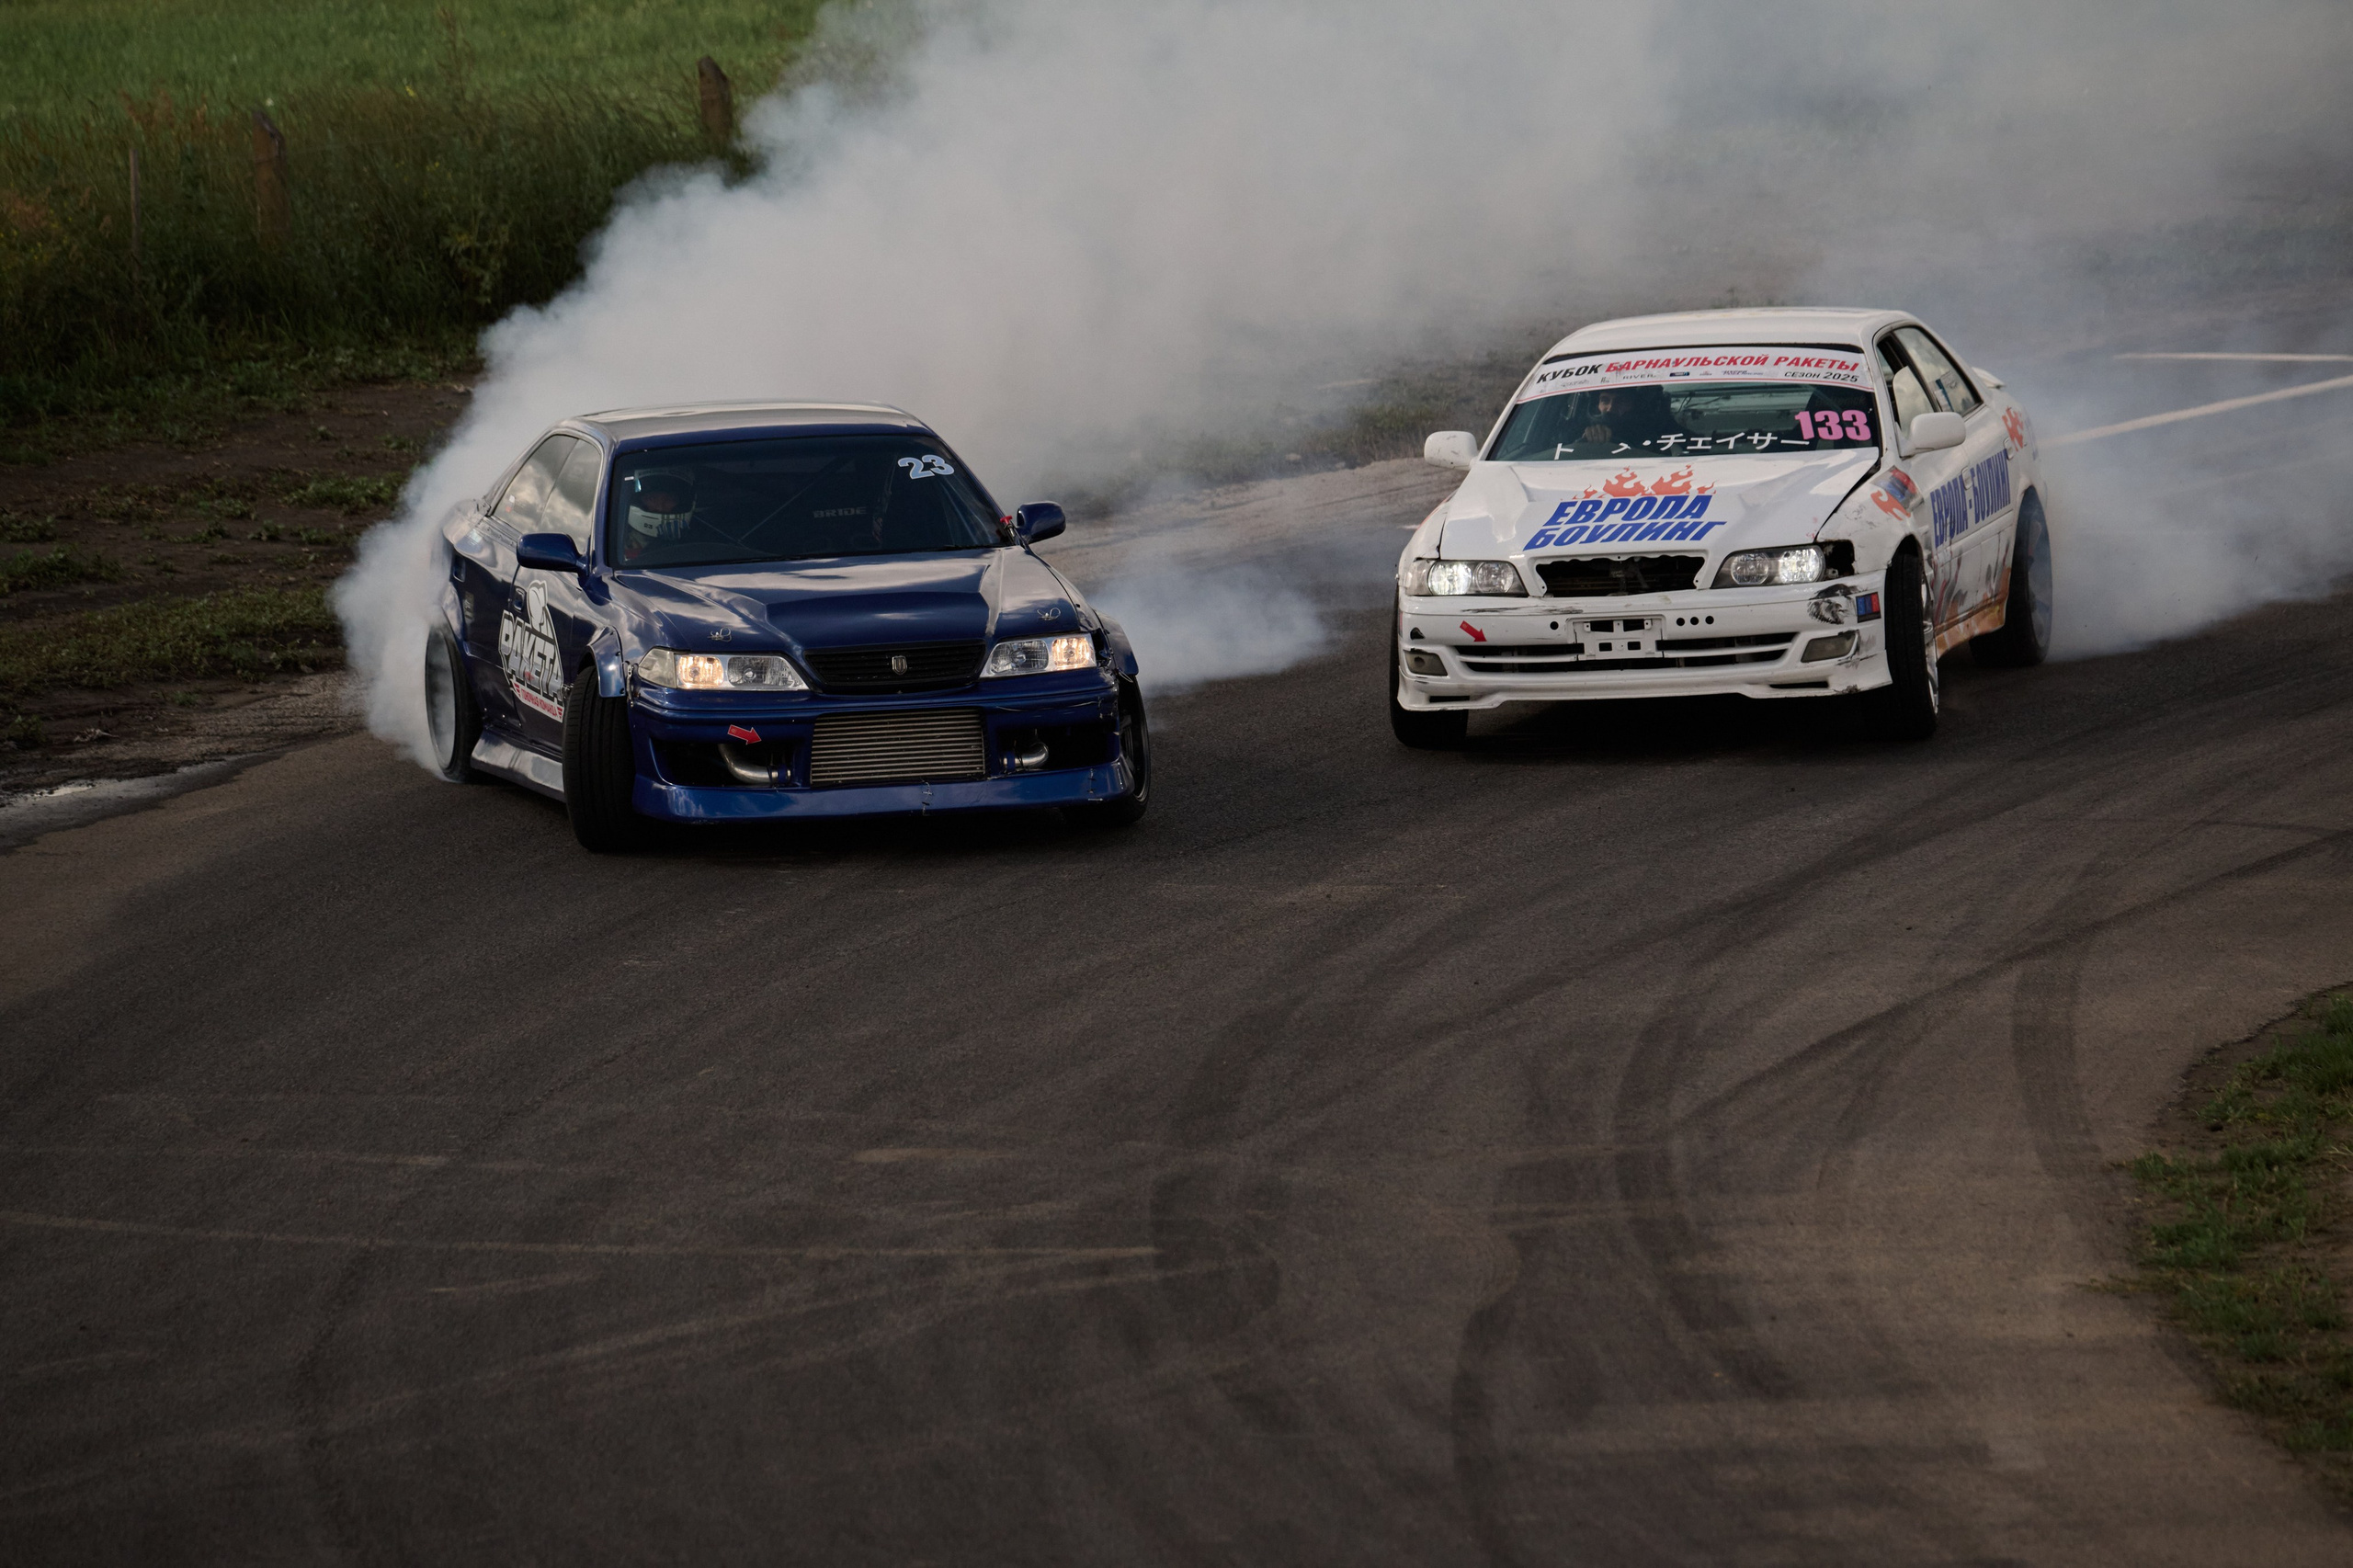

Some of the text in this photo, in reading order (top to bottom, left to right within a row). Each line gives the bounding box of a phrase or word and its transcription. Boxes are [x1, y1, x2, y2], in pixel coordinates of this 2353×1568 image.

[1536, 363, 1603, 384] КУБОК
[1605, 354, 1769, 373] БАРНАУЛЬСКОЙ
[1773, 356, 1860, 371] РАКЕТЫ
[1823, 371, 1859, 383] 2025
[1794, 409, 1871, 441] 133
[897, 454, 955, 480] 23
[813, 507, 867, 517] BRIDE
[1542, 494, 1712, 527] ЕВРОПА
[1930, 474, 1968, 549] ЕВРОПА
[1522, 521, 1727, 551] БОУЛИНГ
[499, 611, 563, 703] РАКЕТА
